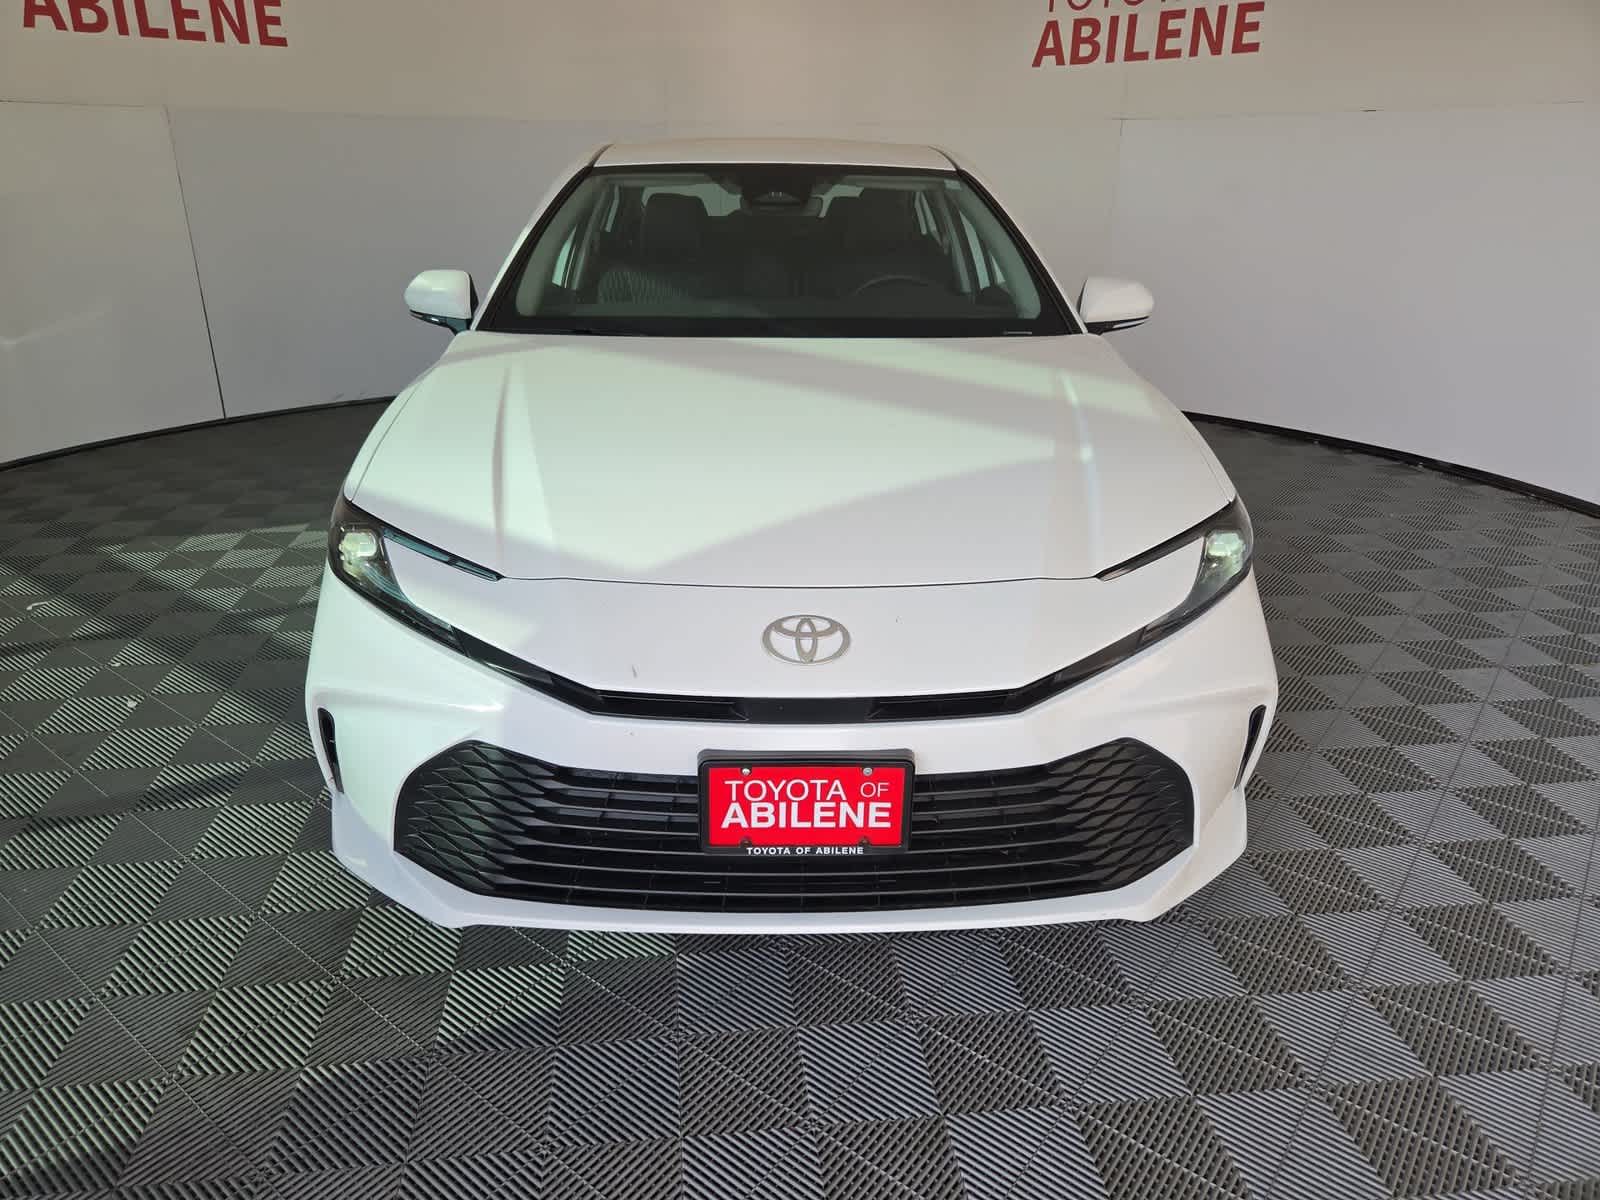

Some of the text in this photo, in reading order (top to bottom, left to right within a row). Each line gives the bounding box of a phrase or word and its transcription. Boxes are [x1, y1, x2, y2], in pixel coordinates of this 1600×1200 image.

[23, 0, 288, 47] ABILENE
[1032, 1, 1265, 68] ABILENE
[724, 779, 889, 801] TOYOTA OF
[721, 801, 892, 828] ABILENE
[746, 847, 864, 855] TOYOTA OF ABILENE
